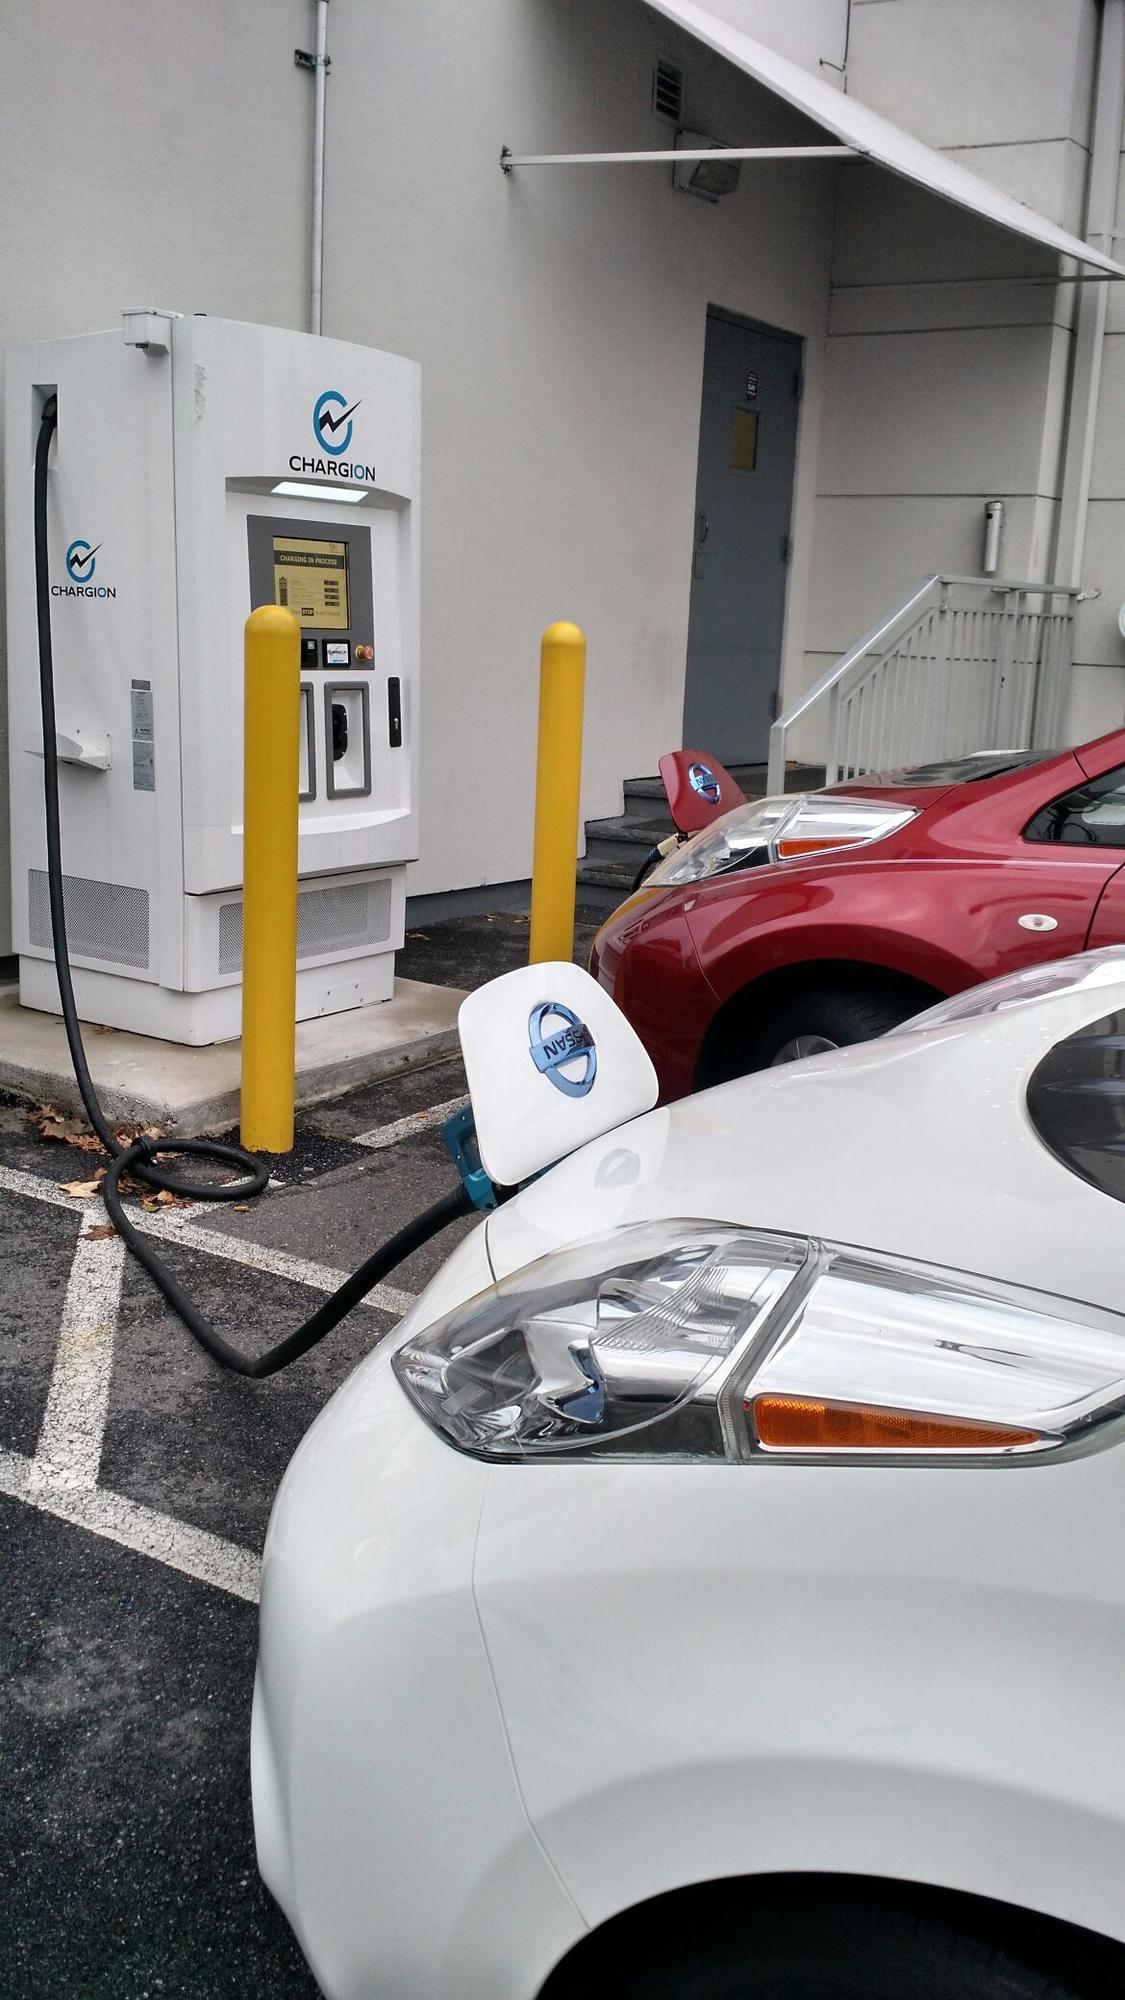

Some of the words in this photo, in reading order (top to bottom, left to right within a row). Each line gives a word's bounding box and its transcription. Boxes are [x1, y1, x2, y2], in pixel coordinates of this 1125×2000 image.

[289, 455, 376, 481] CHARGION
[280, 554, 307, 563] CHARGING
[315, 557, 337, 565] PROCESS
[51, 585, 116, 598] CHARGION
